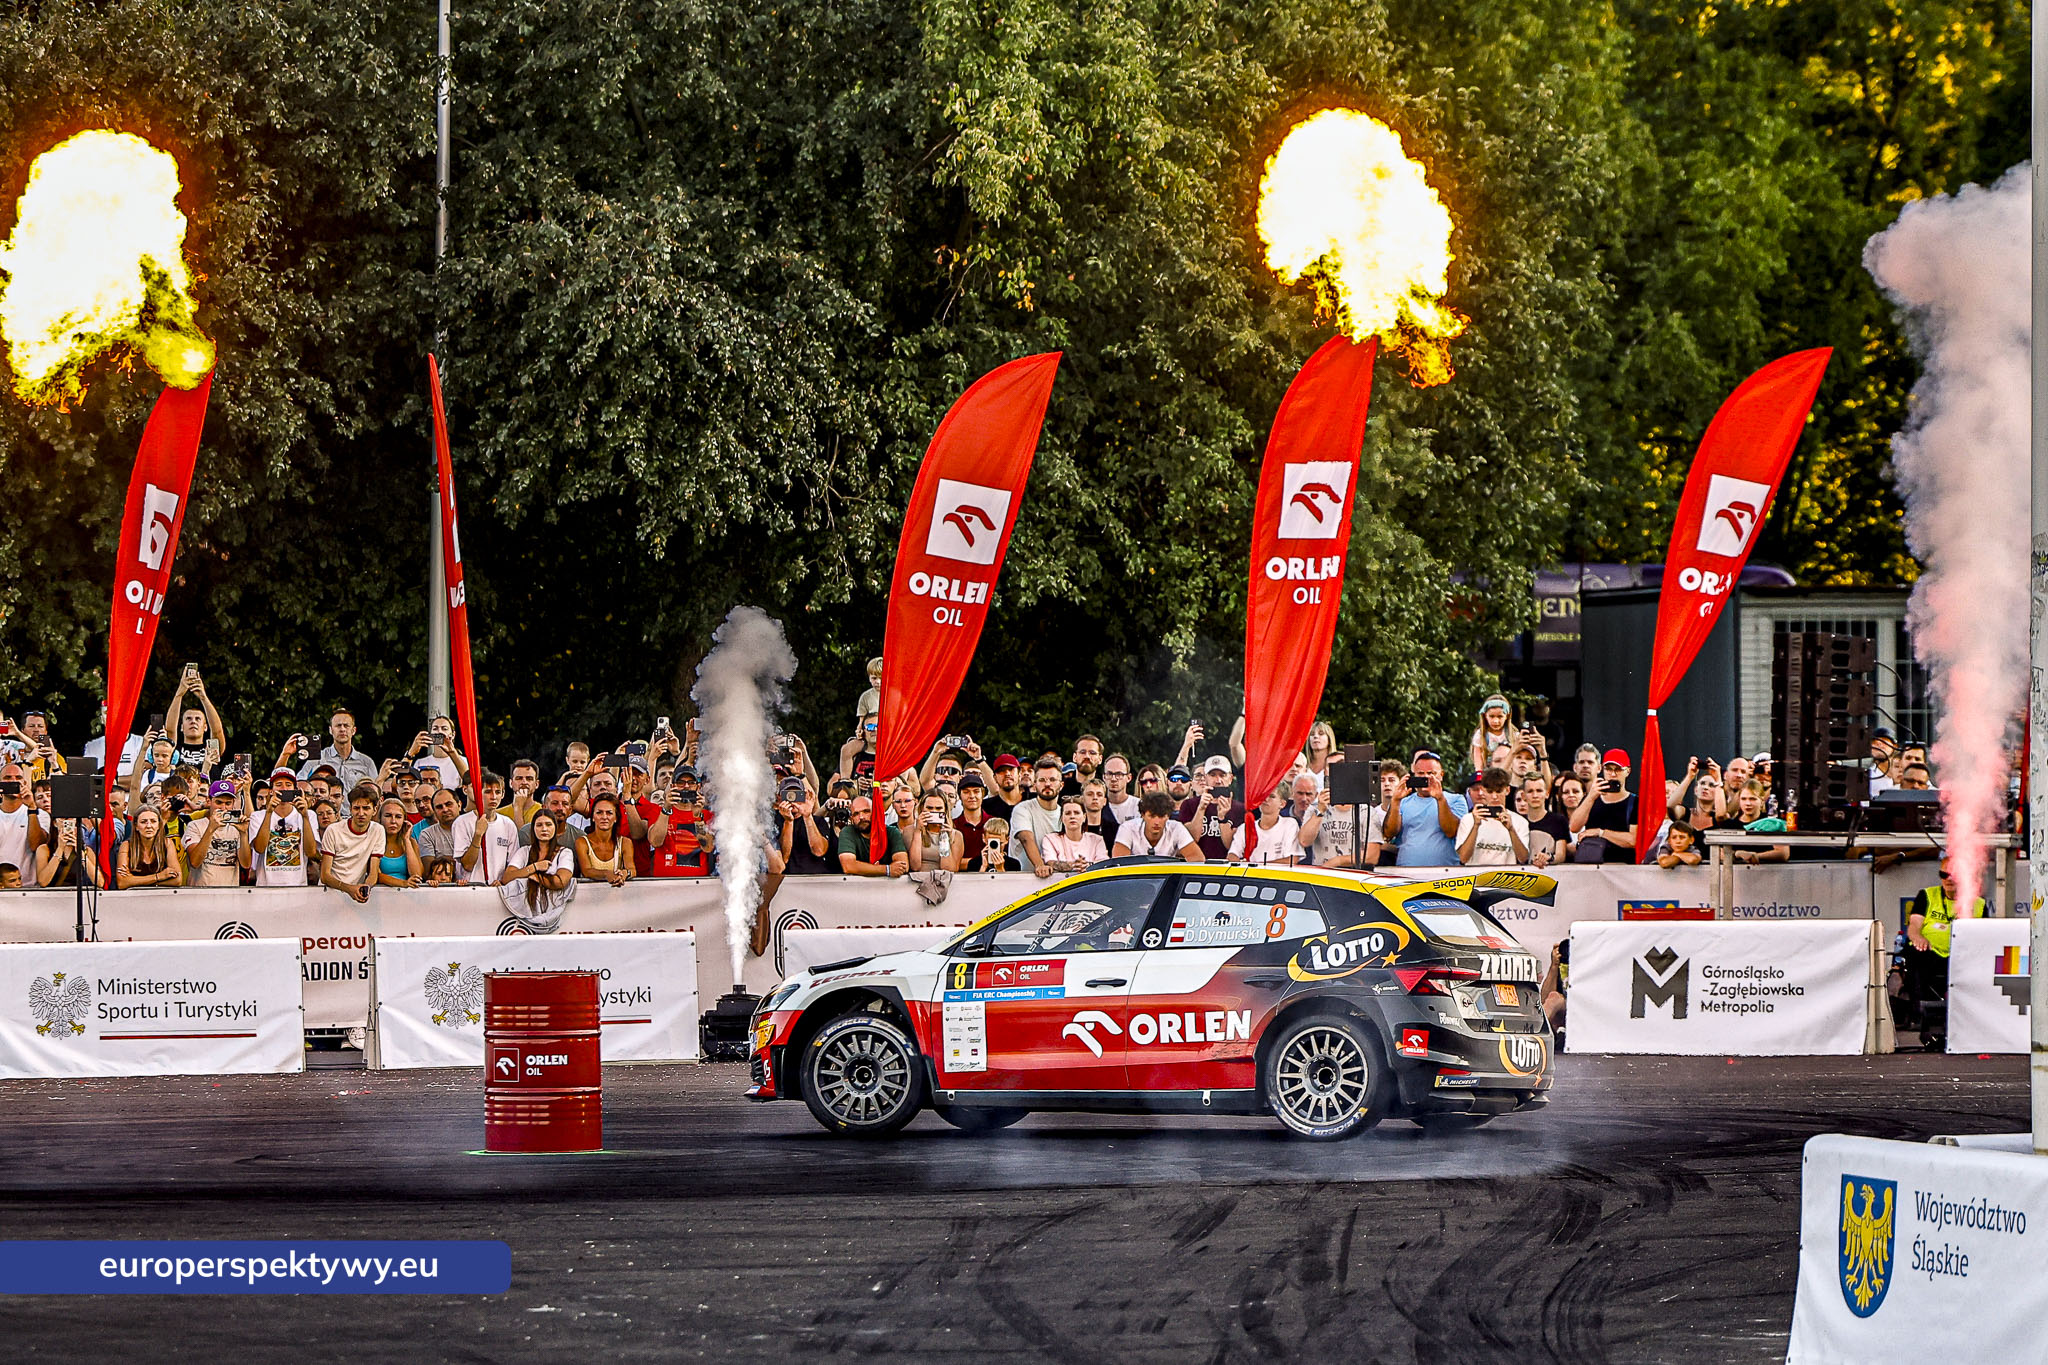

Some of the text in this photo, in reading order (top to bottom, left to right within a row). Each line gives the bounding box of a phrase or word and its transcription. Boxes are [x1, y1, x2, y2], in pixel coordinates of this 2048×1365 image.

[1293, 586, 1321, 605] OIL
[933, 606, 963, 627] OIL
[1266, 903, 1288, 938] 8
[1311, 933, 1384, 971] LOTTO
[954, 963, 967, 989] 8
[1019, 964, 1050, 973] ORLEN
[1702, 965, 1785, 982] Górnośląsko
[97, 978, 217, 995] Ministerstwo
[600, 986, 651, 1008] ystyki
[996, 990, 1036, 998] Championship
[97, 1000, 257, 1022] Sportu i Turystyki
[1700, 1000, 1774, 1016] Metropolia
[1129, 1010, 1252, 1045] ORLEN
[526, 1055, 568, 1066] ORLEN
[1509, 1034, 1541, 1068] LOTTO
[526, 1067, 543, 1076] OIL
[1914, 1190, 2027, 1235] Województwo
[1911, 1234, 1970, 1281] Śląskie
